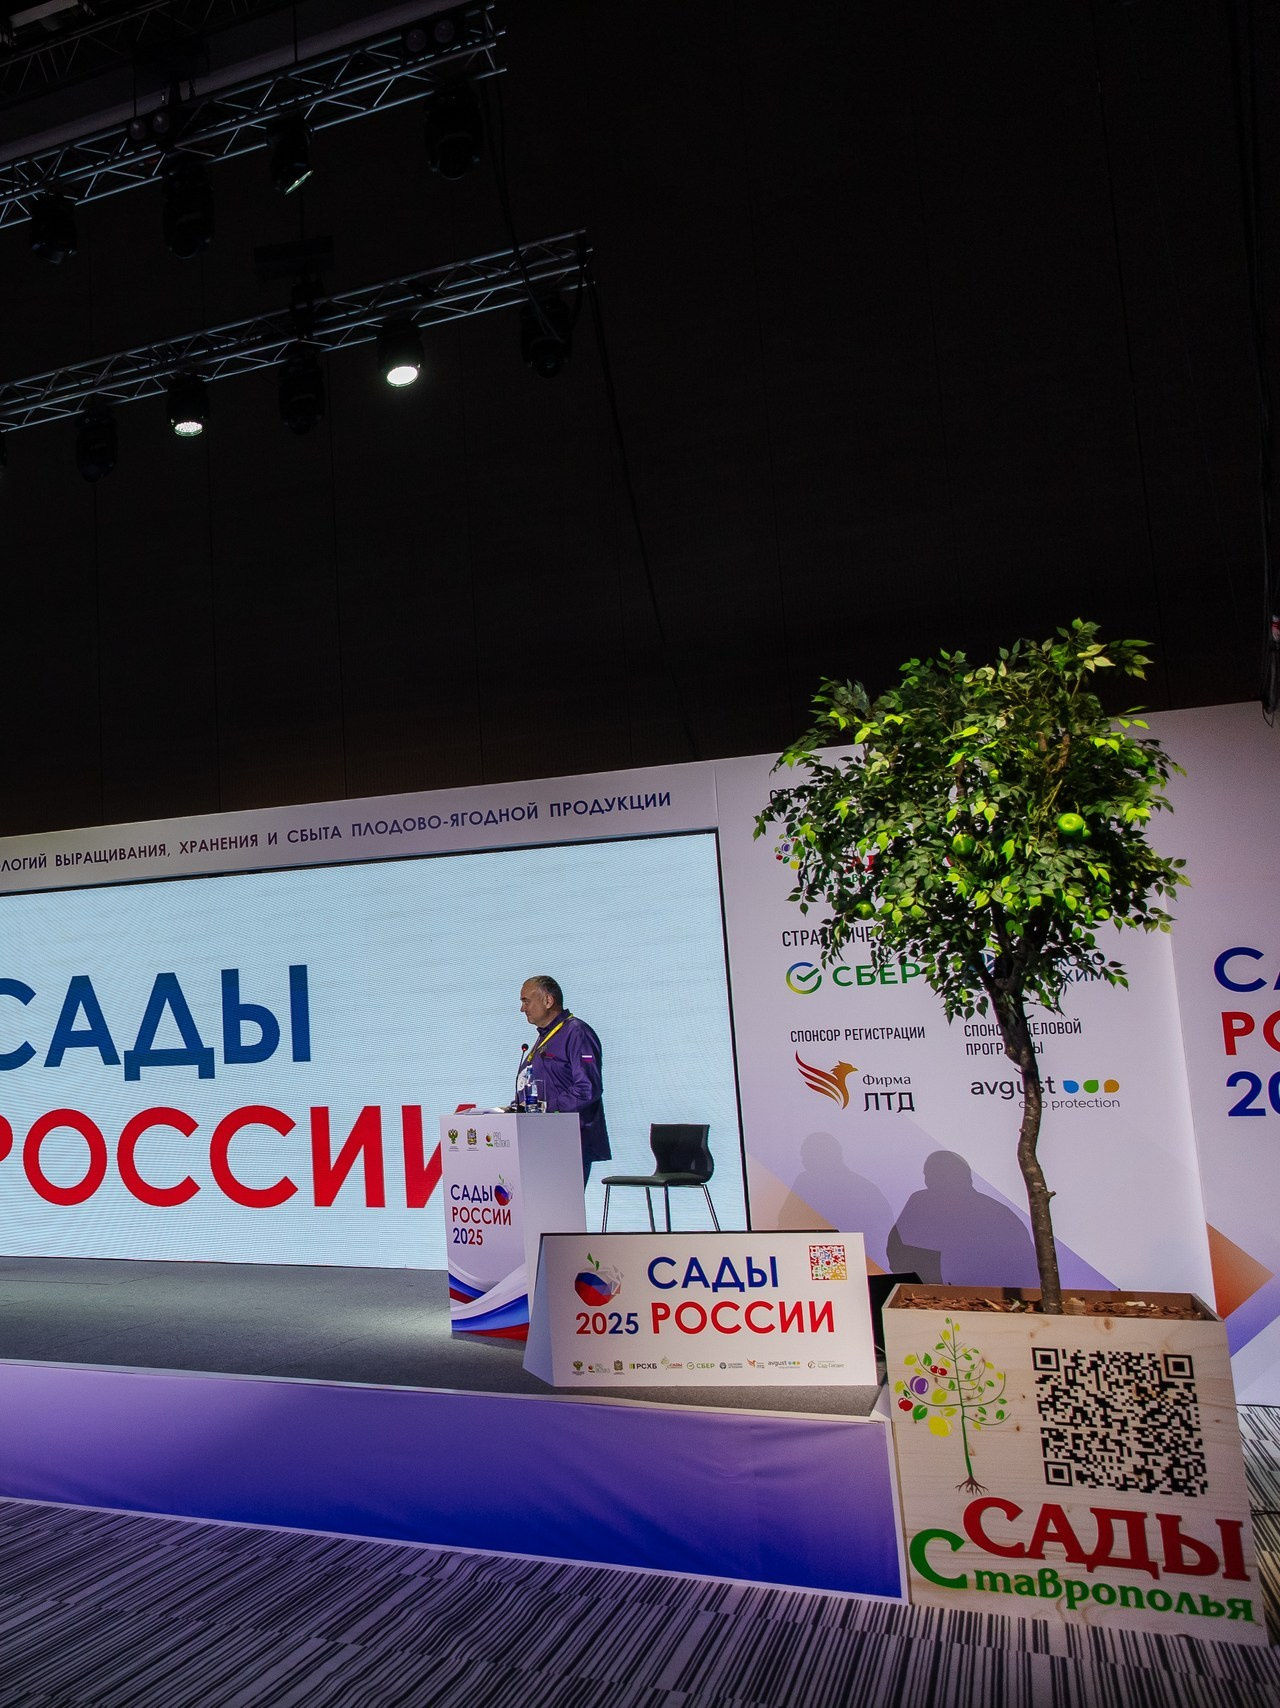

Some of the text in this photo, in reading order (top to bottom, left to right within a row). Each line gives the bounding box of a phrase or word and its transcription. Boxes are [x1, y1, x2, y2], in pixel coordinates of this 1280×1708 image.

[55, 843, 171, 868] ВЫРАЩИВАНИЯ,
[179, 834, 259, 854] ХРАНЕНИЯ
[267, 832, 278, 845] И
[287, 825, 342, 843] СБЫТА
[351, 802, 538, 838] ПЛОДОВО-ЯГОДНОЙ
[550, 791, 672, 818] ПРОДУКЦИИ
[832, 962, 920, 987] СБЕР
[790, 1026, 925, 1042] СПОНСОР РЕГИСТРАЦИИ
[966, 1042, 1044, 1055] ПРОГРЫ
[862, 1074, 911, 1087] Фирма
[864, 1091, 915, 1113] ЛТД
[1052, 1098, 1120, 1110] protection
[450, 1184, 493, 1203] САДЫ
[452, 1206, 511, 1226] РОССИИ
[453, 1227, 483, 1246] 2025
[648, 1256, 779, 1293] САДЫ
[576, 1300, 835, 1335] 2025 РОССИИ
[962, 1496, 1251, 1582] САДЫ
[908, 1528, 1255, 1624] Ставрополья
